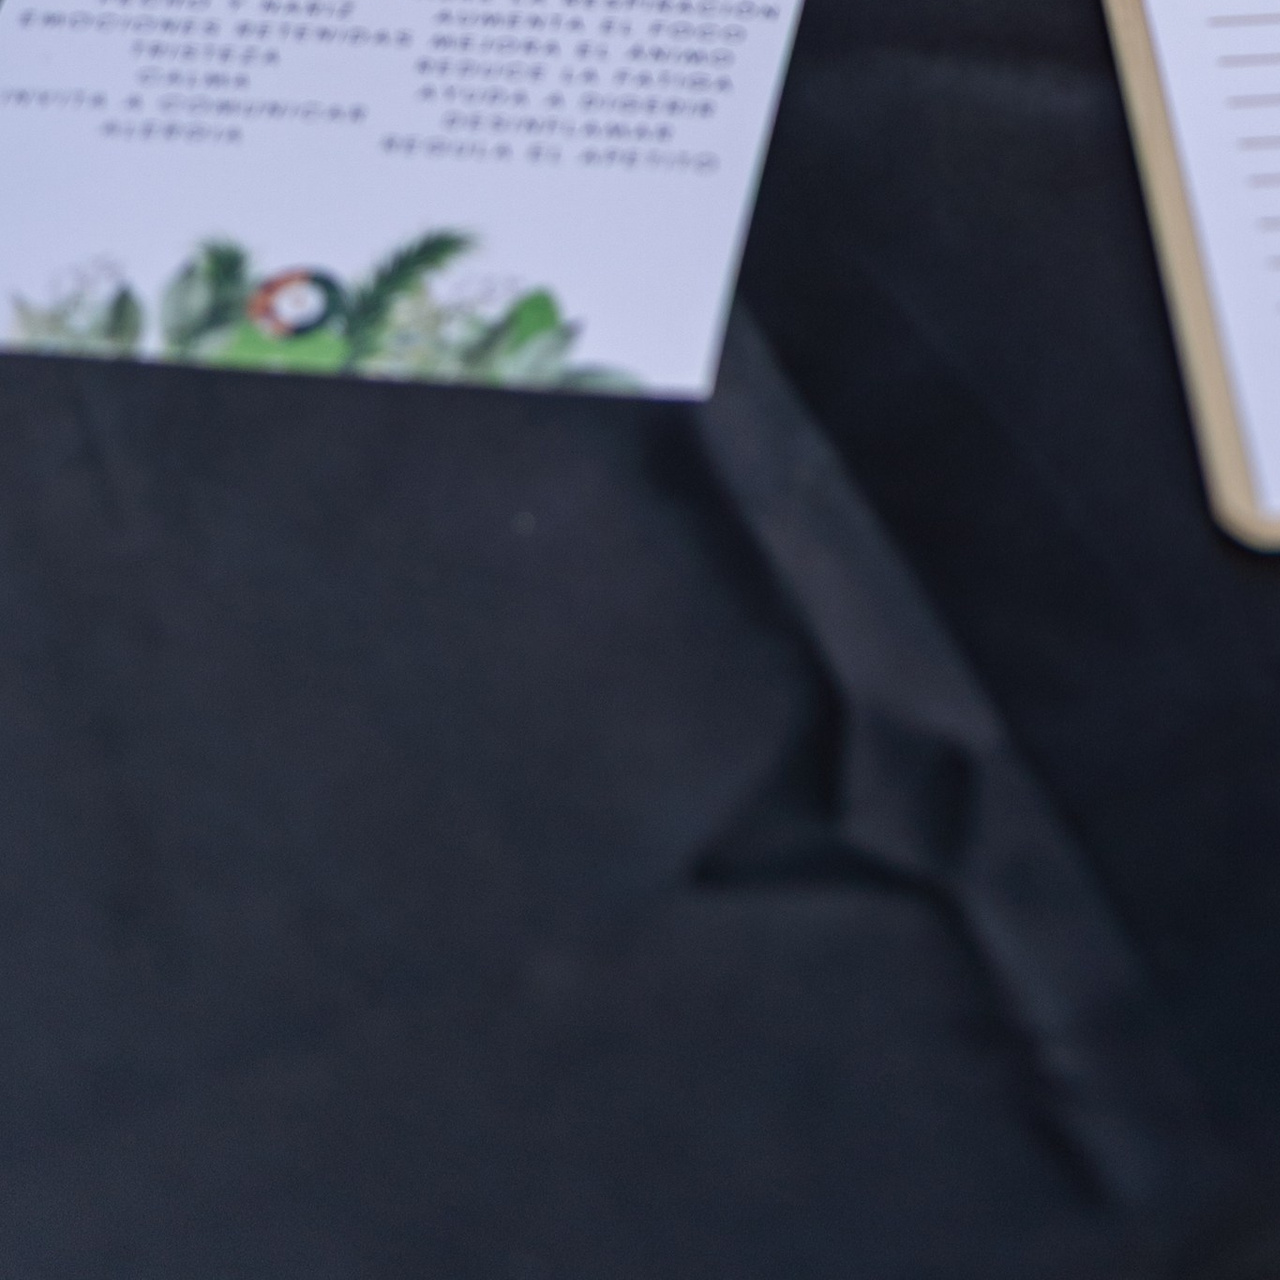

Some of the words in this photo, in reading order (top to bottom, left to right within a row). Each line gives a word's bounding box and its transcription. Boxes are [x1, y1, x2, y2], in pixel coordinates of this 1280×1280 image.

[18, 7, 222, 39] EMOCIONES
[235, 18, 414, 50] RETENIDAS
[433, 7, 587, 34] AUMENTA
[131, 39, 281, 67] TRISTEZA
[431, 30, 562, 57] MEJORA
[135, 65, 252, 90] CALMA
[414, 55, 547, 83] REDUCE
